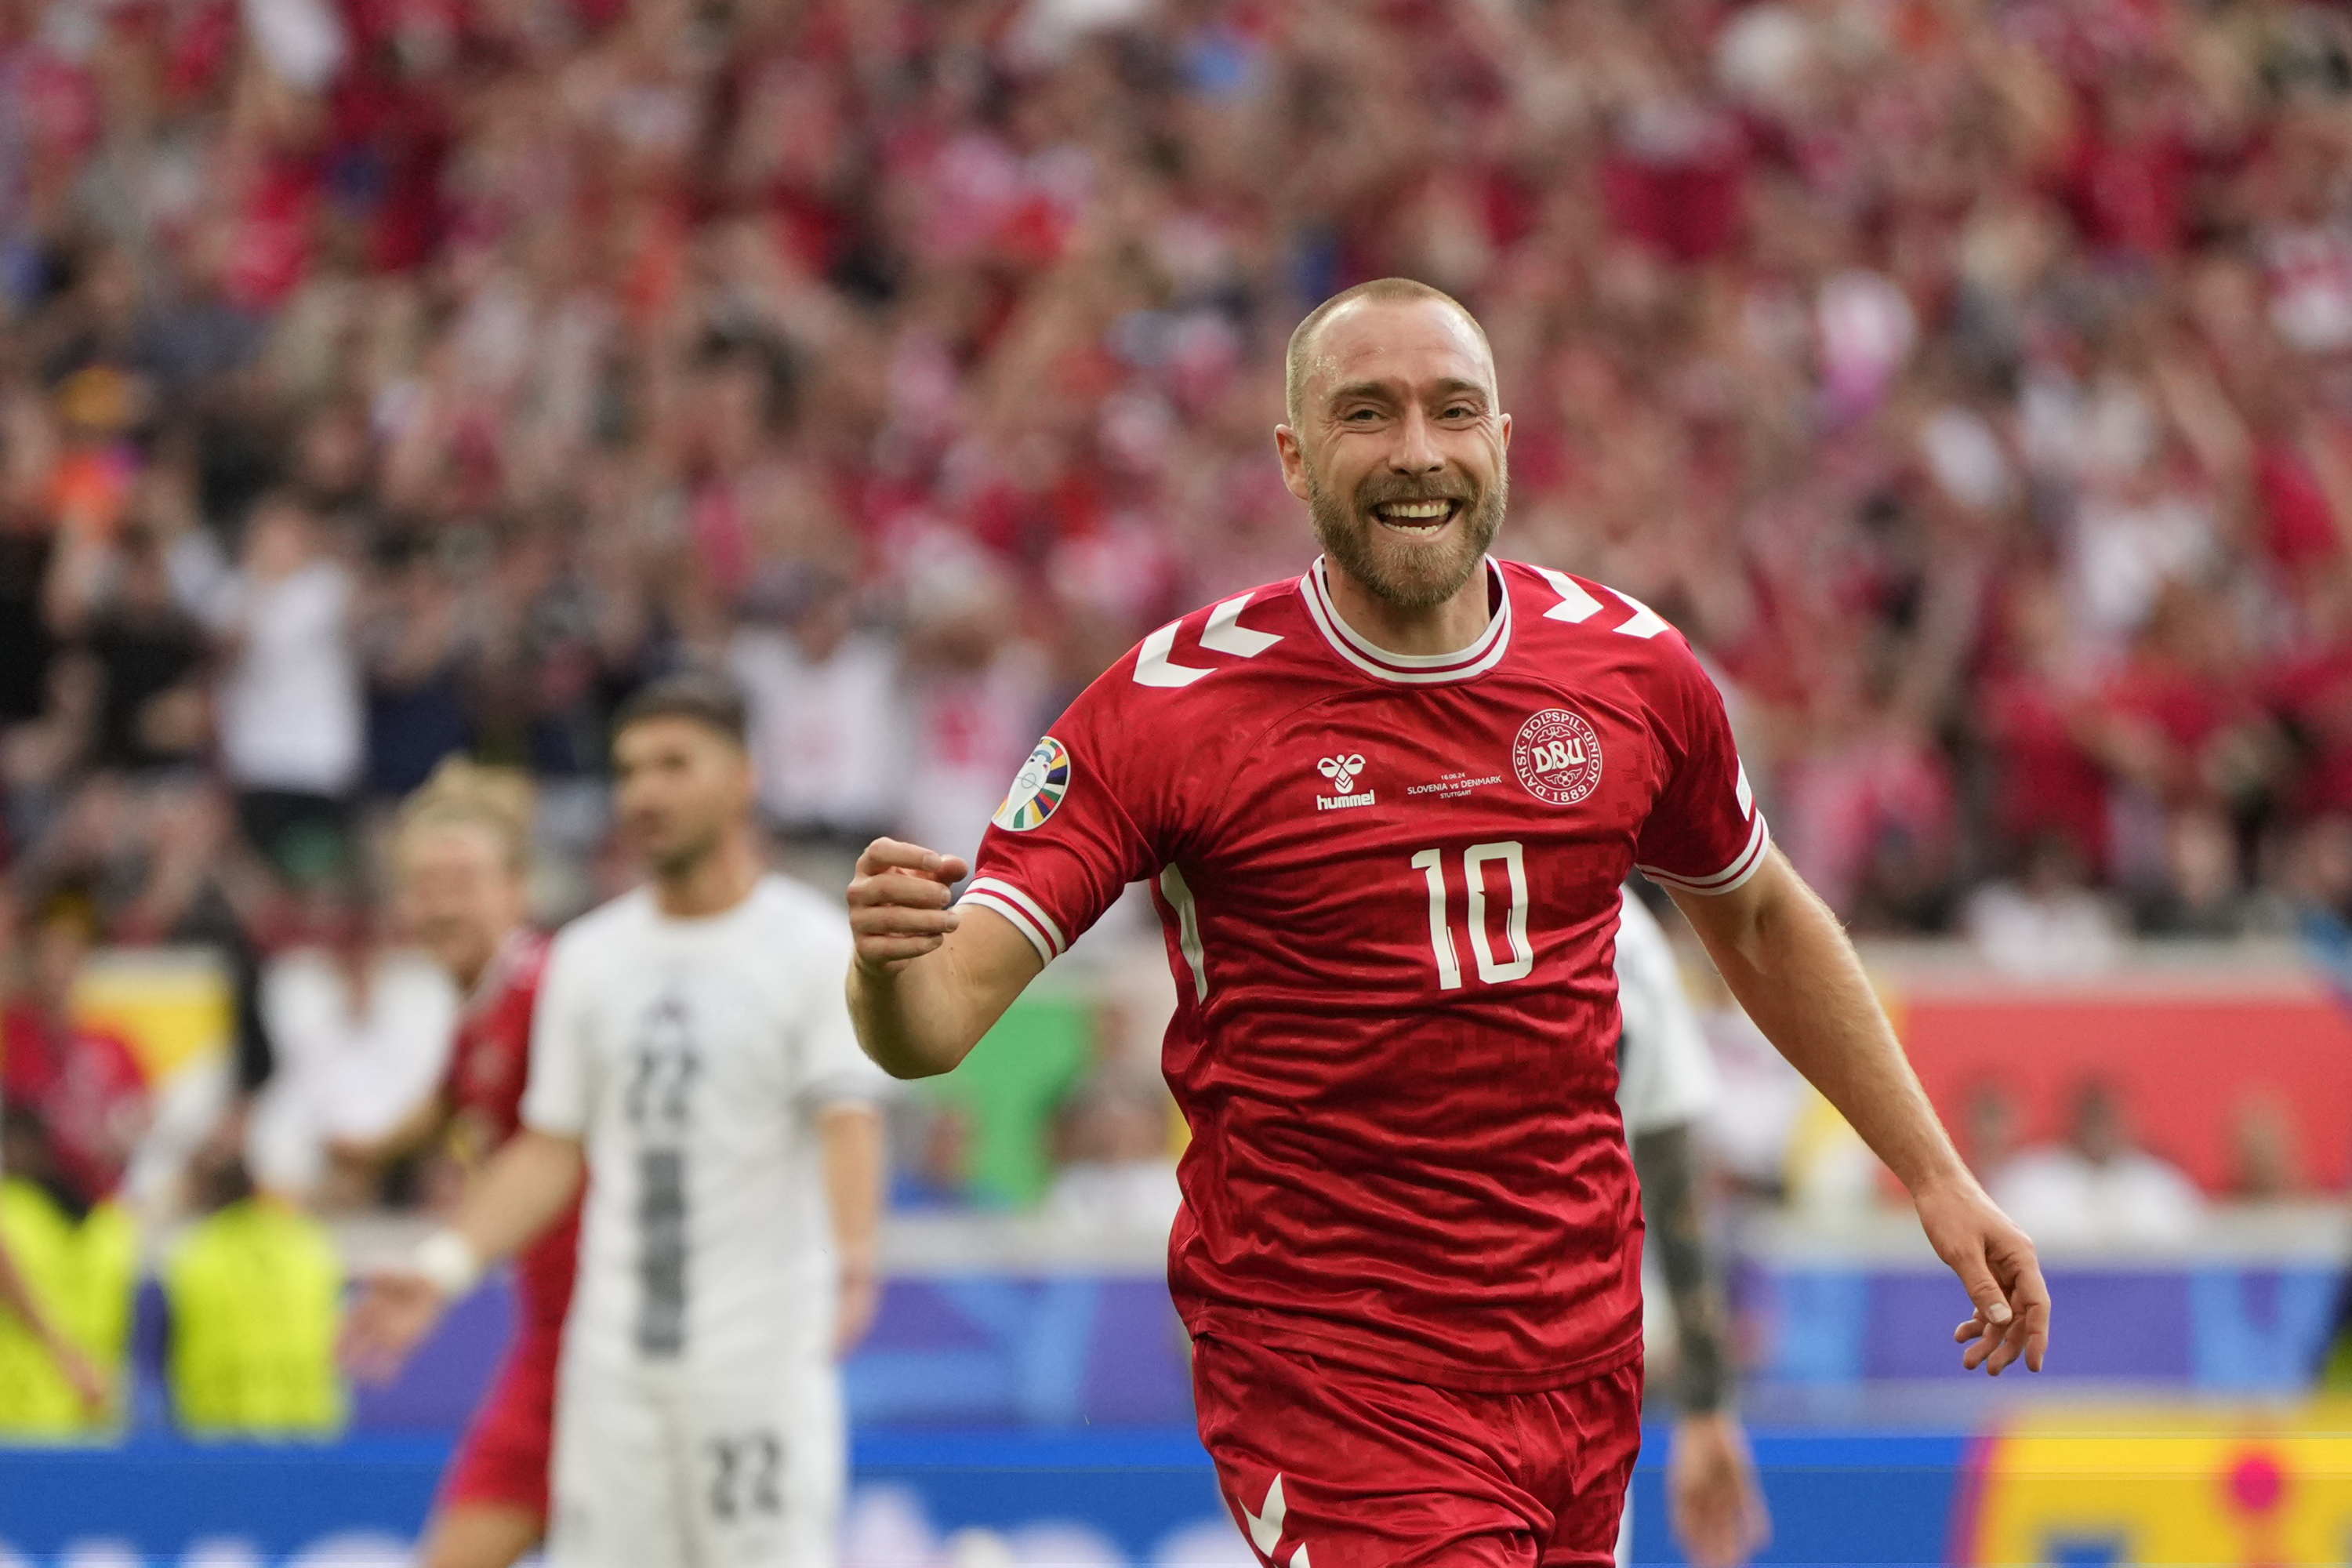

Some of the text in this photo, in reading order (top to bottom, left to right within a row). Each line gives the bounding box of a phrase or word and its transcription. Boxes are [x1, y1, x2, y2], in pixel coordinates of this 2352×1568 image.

[1516, 744, 1547, 797] DANSK
[1552, 785, 1588, 802] 1889
[1531, 737, 1587, 774] DBU
[1316, 789, 1376, 811] hummel
[1407, 783, 1448, 794] SLOVENIA
[1461, 775, 1502, 788] DENMARK
[1440, 789, 1472, 798] STUTTGART
[1411, 840, 1534, 990] 10
[706, 1427, 786, 1525] 22
